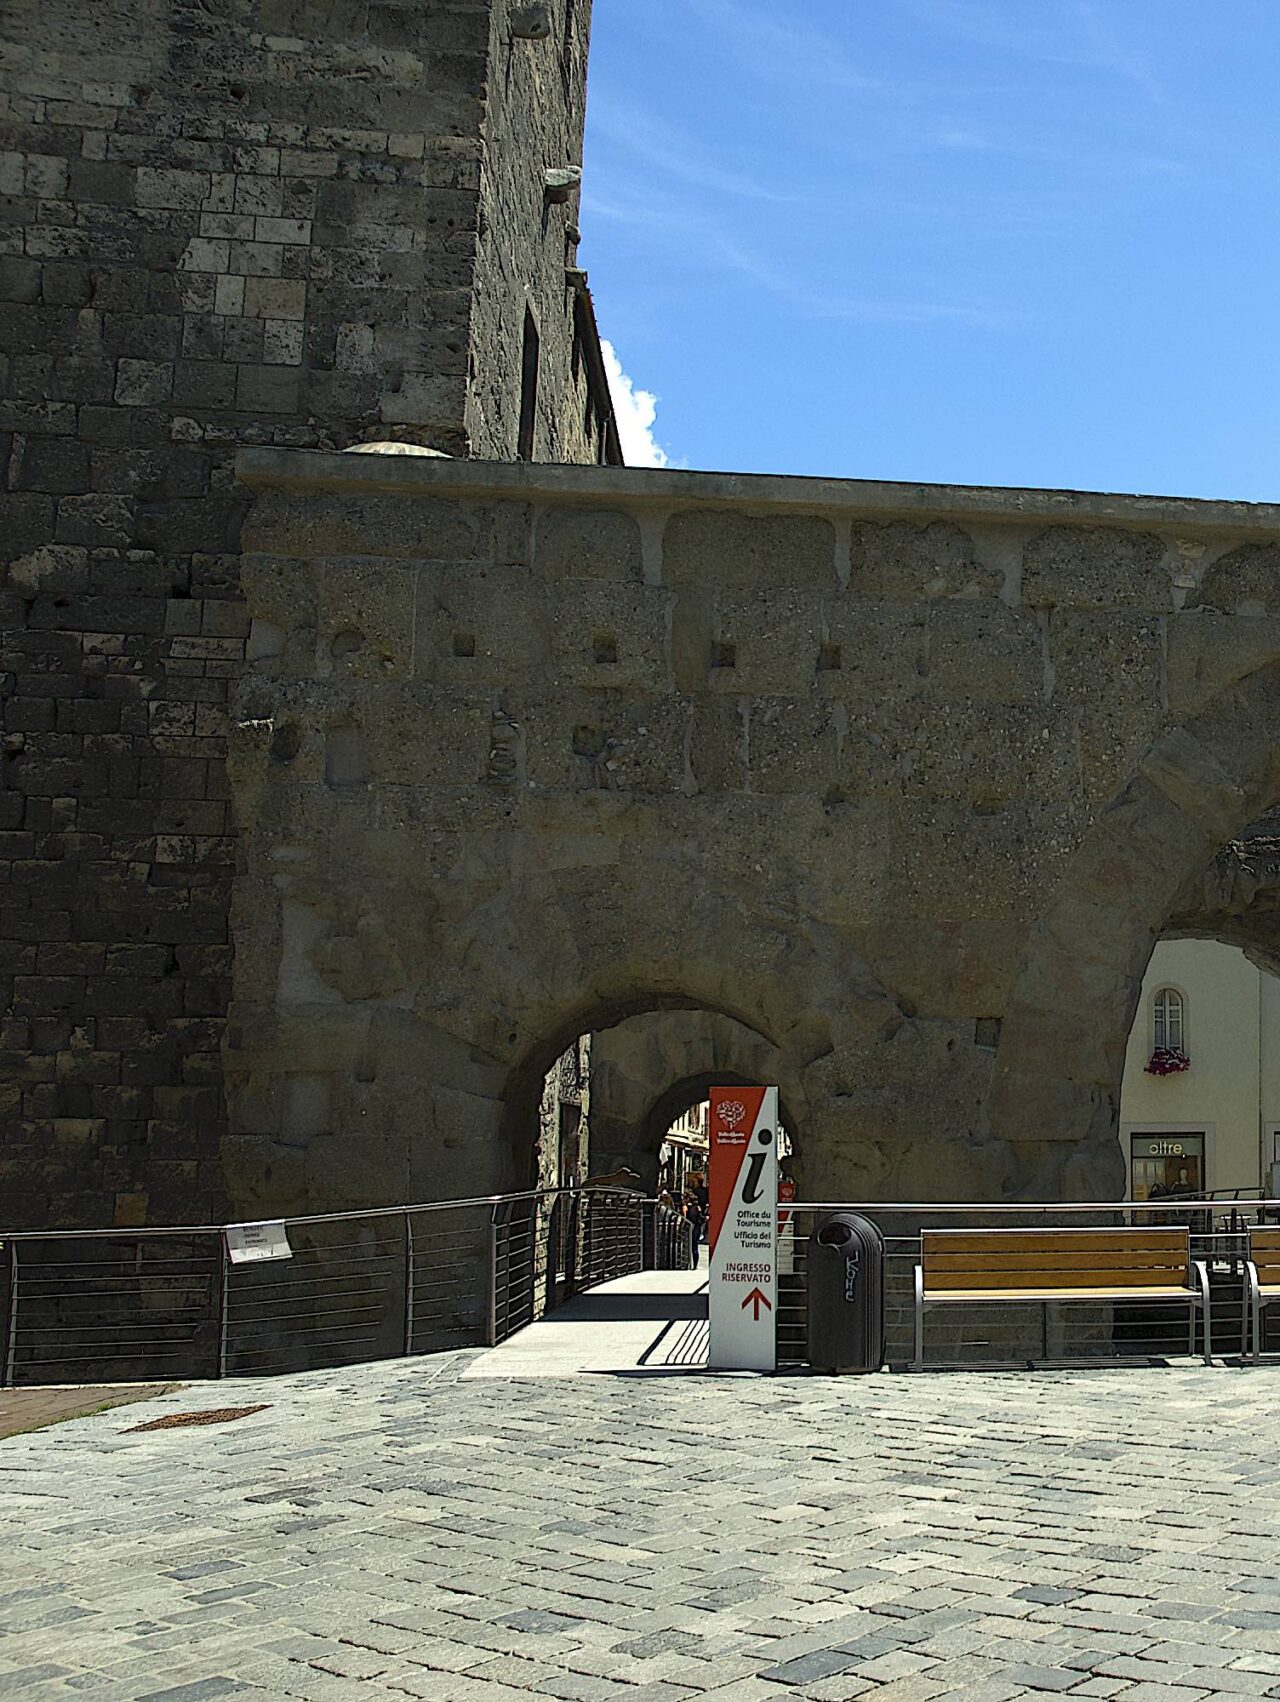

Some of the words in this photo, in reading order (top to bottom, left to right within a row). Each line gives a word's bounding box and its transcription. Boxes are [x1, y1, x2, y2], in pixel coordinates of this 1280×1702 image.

[1149, 1141, 1182, 1154] oltre
[737, 1210, 760, 1218] Office
[761, 1210, 771, 1218] du
[736, 1219, 771, 1228] Tourisme
[734, 1231, 758, 1239] Ufficio
[759, 1231, 771, 1239] del
[741, 1240, 771, 1248] Turismo
[726, 1263, 771, 1273] INGRESSO
[722, 1273, 771, 1283] RISERVATO
